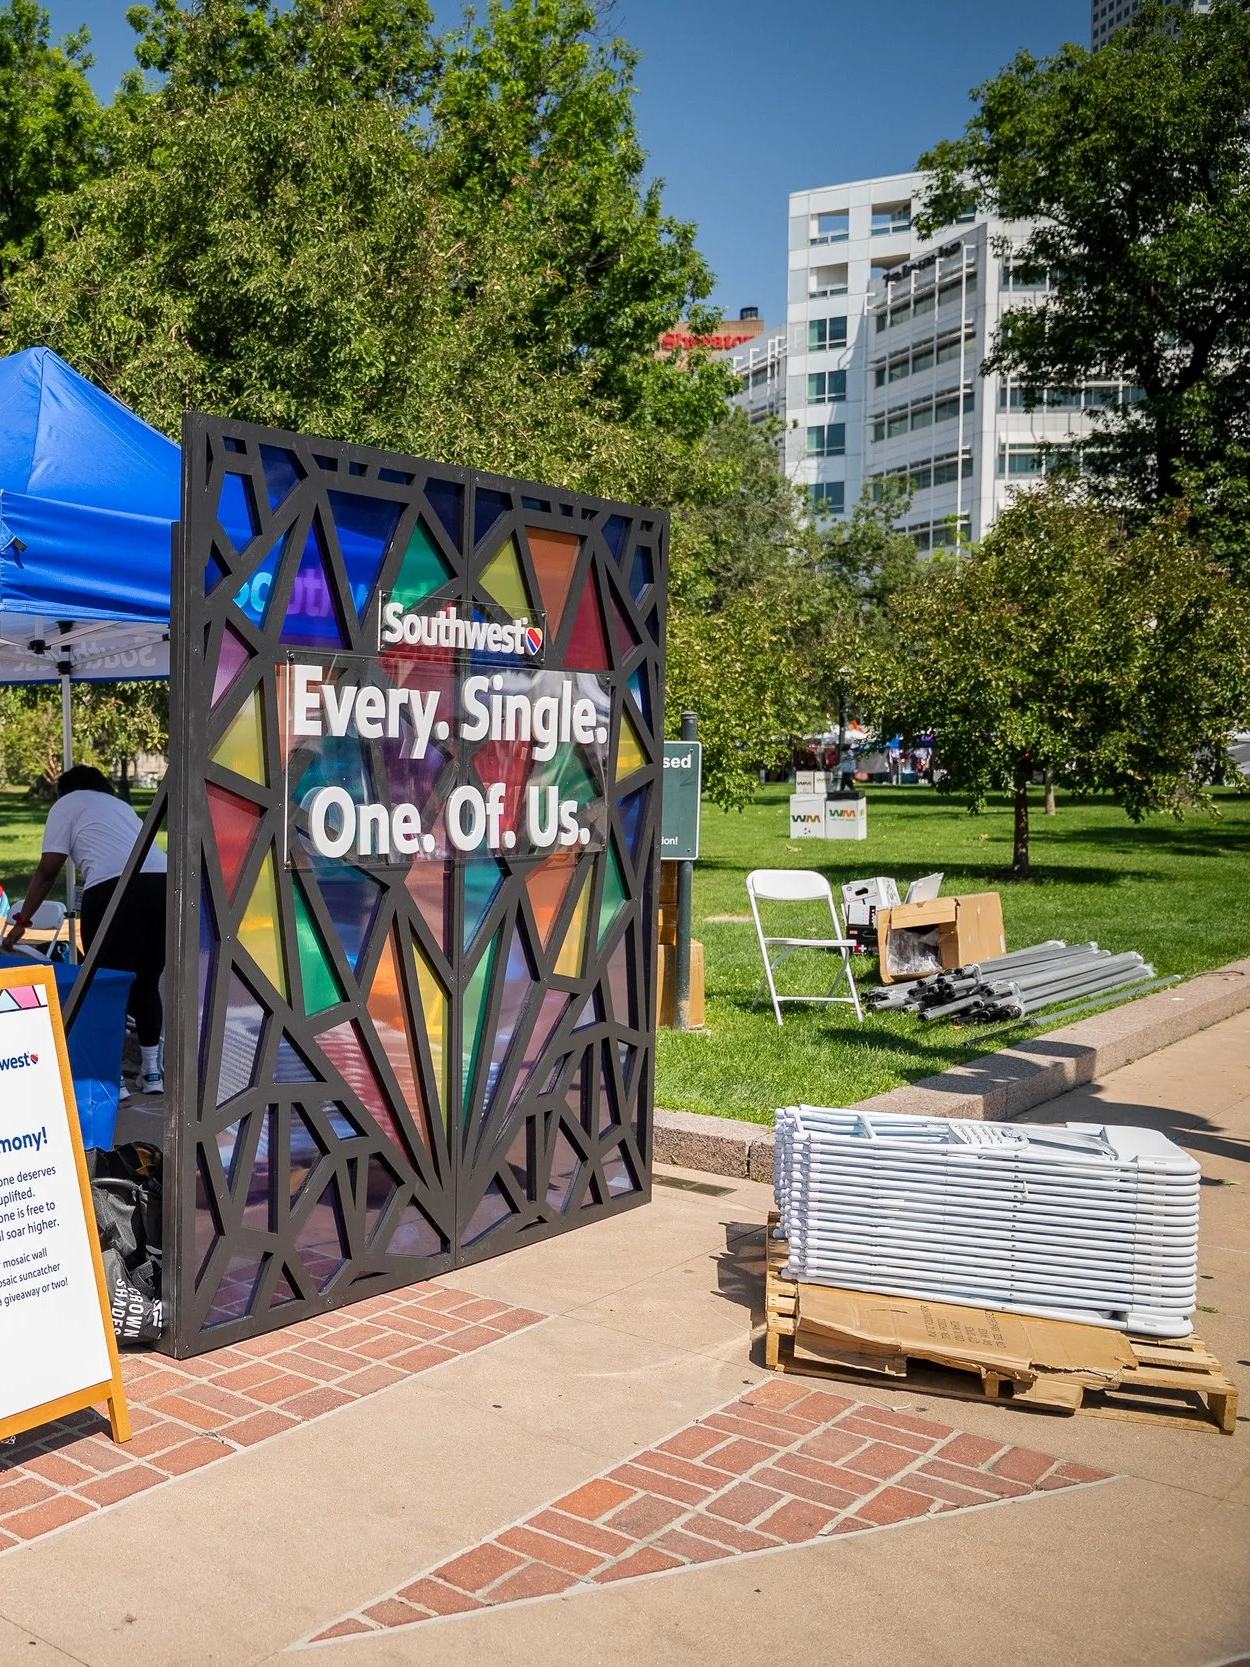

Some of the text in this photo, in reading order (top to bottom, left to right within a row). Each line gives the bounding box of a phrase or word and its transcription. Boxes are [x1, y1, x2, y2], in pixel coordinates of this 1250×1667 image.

[662, 332, 754, 350] Sherato
[382, 600, 527, 655] Southwest
[292, 665, 609, 762] Every. Single.
[663, 754, 692, 769] sed
[308, 784, 592, 859] One. Of. Us.
[791, 814, 821, 823] WM
[828, 809, 856, 817] WM
[661, 836, 678, 846] ion!
[17, 1166, 56, 1183] deserves
[17, 1208, 25, 1219] is
[26, 1205, 45, 1217] free
[46, 1202, 56, 1212] to
[6, 1227, 26, 1240] soar
[27, 1219, 60, 1235] higher.
[3, 1254, 31, 1269] mosaic
[32, 1248, 48, 1260] wall
[19, 1264, 61, 1282] suncatcher
[4, 1288, 41, 1307] giveaway
[42, 1284, 50, 1293] or
[51, 1277, 69, 1290] two!
